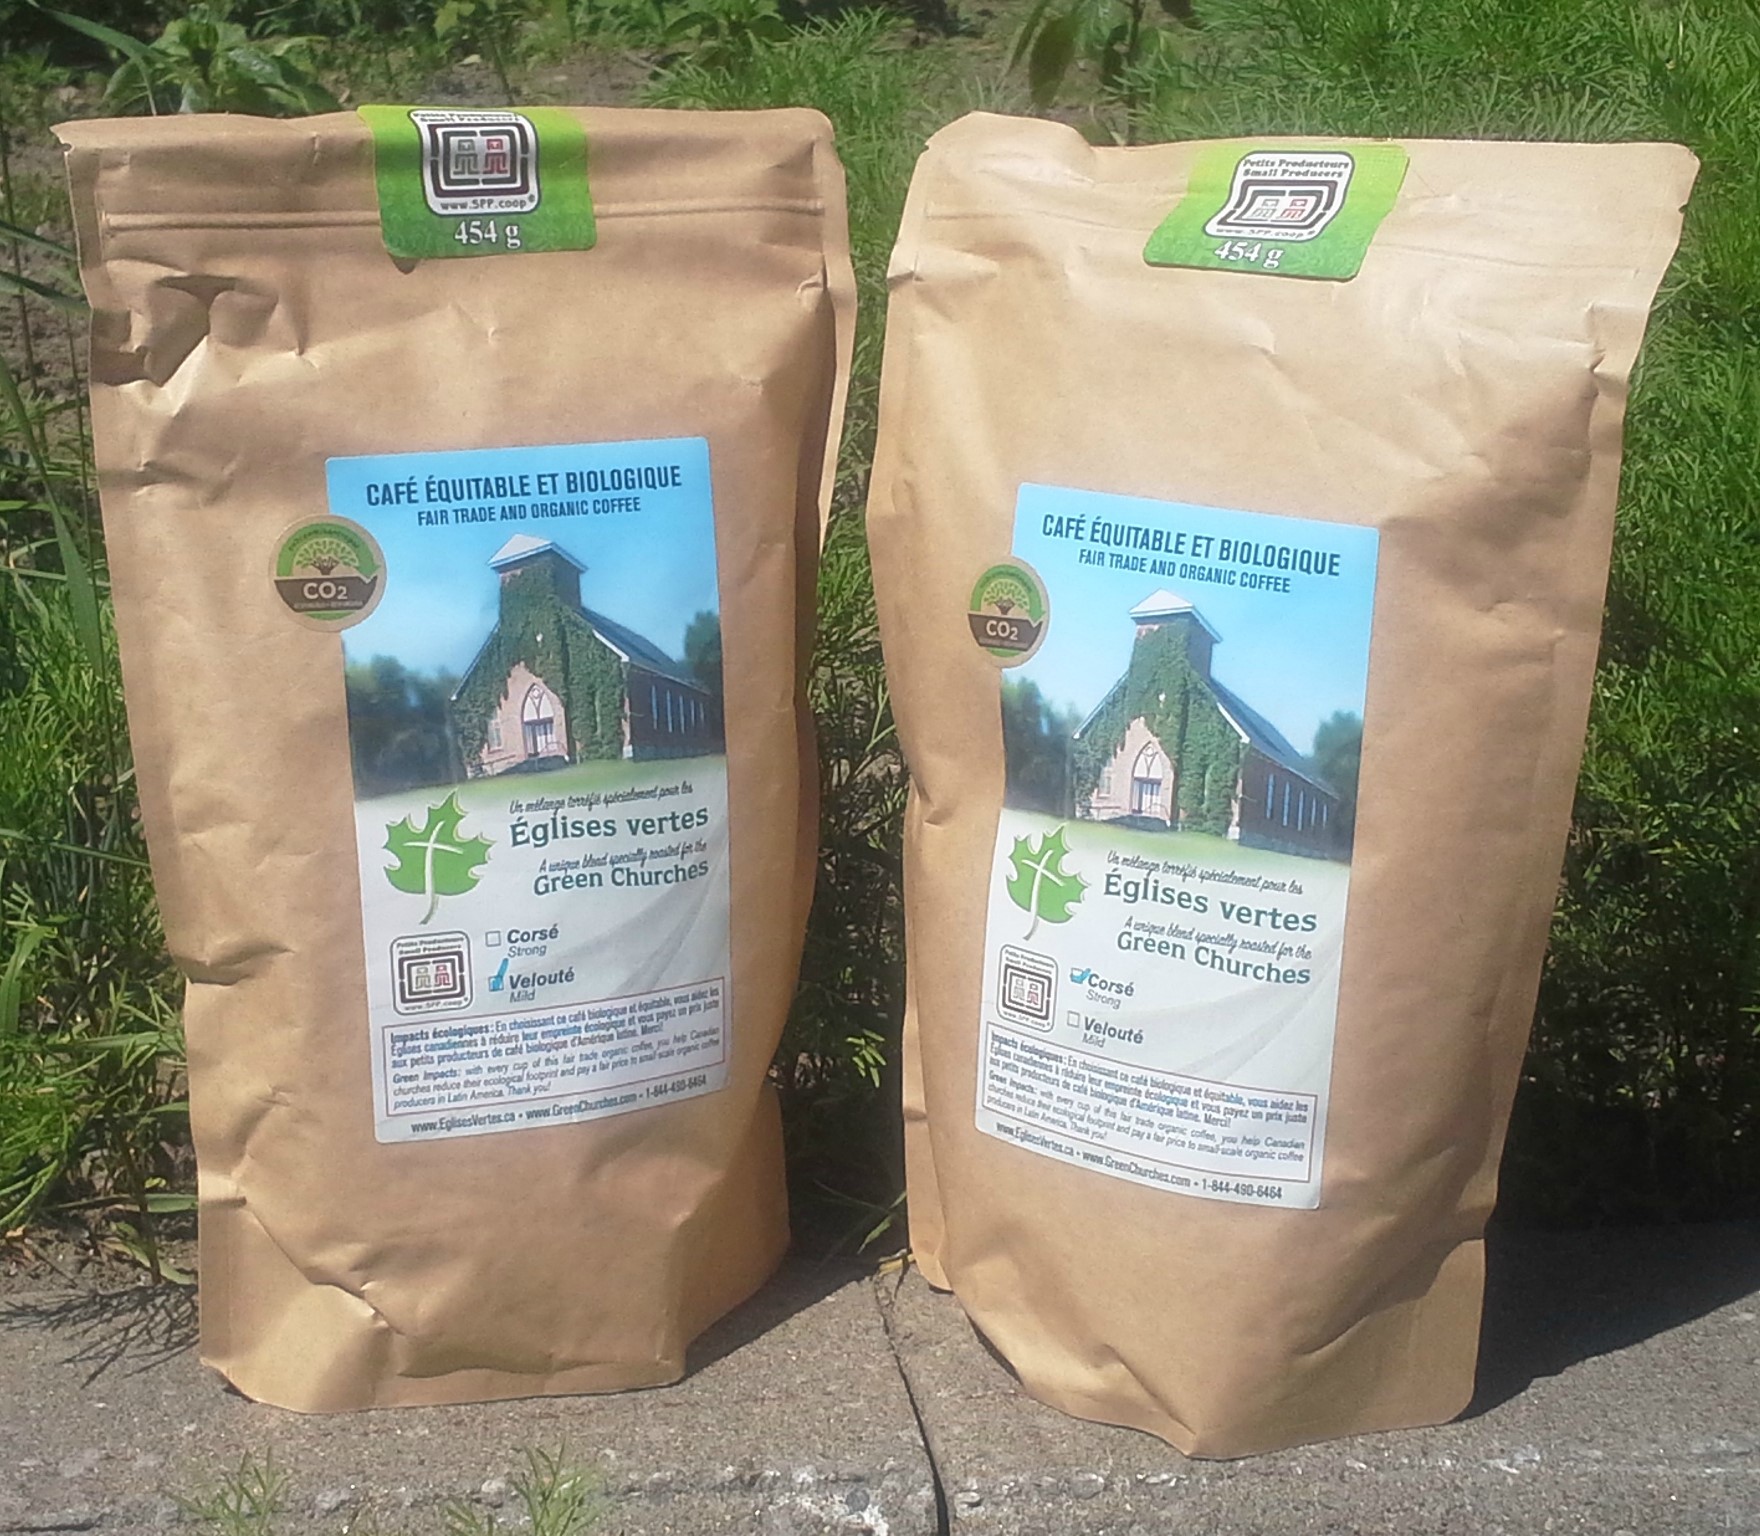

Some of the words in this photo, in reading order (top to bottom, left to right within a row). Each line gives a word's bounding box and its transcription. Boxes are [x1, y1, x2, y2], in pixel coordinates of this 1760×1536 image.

[1242, 158, 1276, 168] Petits
[1278, 158, 1350, 169] Producteurs
[1242, 168, 1278, 178] Small
[1280, 168, 1343, 179] Producers
[440, 198, 527, 210] www.SPP.coop
[455, 220, 497, 244] 454
[504, 225, 523, 250] g
[1214, 240, 1262, 263] 454
[1262, 249, 1285, 270] g
[366, 476, 419, 506] CAFÉ
[426, 474, 531, 505] ÉQUITABLE
[538, 473, 559, 496] ET
[566, 465, 683, 498] BIOLOGIQUE
[418, 510, 449, 527] FAIR
[453, 507, 496, 524] TRADE
[500, 504, 527, 522] AND
[531, 500, 589, 519] ORGANIC
[592, 497, 641, 515] COFFEE
[1042, 514, 1085, 541] CAFÉ
[1089, 516, 1187, 556] ÉQUITABLE
[1191, 534, 1215, 560] ET
[1219, 539, 1341, 577] BIOLOGIQUE
[1079, 549, 1105, 567] FAIR
[1108, 552, 1147, 574] TRADE
[1149, 558, 1176, 577] AND
[1179, 563, 1236, 588] ORGANIC
[1240, 572, 1291, 593] COFFEE
[510, 815, 617, 848] Églises
[626, 807, 709, 837] vertes
[534, 871, 603, 896] Green
[611, 860, 709, 887] Churches
[539, 859, 547, 873] A
[1104, 868, 1208, 914] Églises
[1220, 900, 1317, 932] vertes
[507, 923, 559, 945] Corsé
[1124, 916, 1133, 928] A
[1277, 942, 1294, 961] for
[1295, 944, 1312, 960] the
[507, 945, 547, 959] Strong
[1117, 931, 1186, 960] Green
[1194, 946, 1310, 984] Churches
[509, 967, 575, 990] Velouté
[1088, 973, 1134, 997] Corsé
[510, 989, 536, 1003] Mild
[1086, 989, 1121, 1010] Strong
[1082, 1033, 1105, 1048] Mild
[1085, 1016, 1143, 1044] Velouté
[393, 1073, 419, 1084] Green
[1202, 1178, 1282, 1199] 1-844-490-6464
